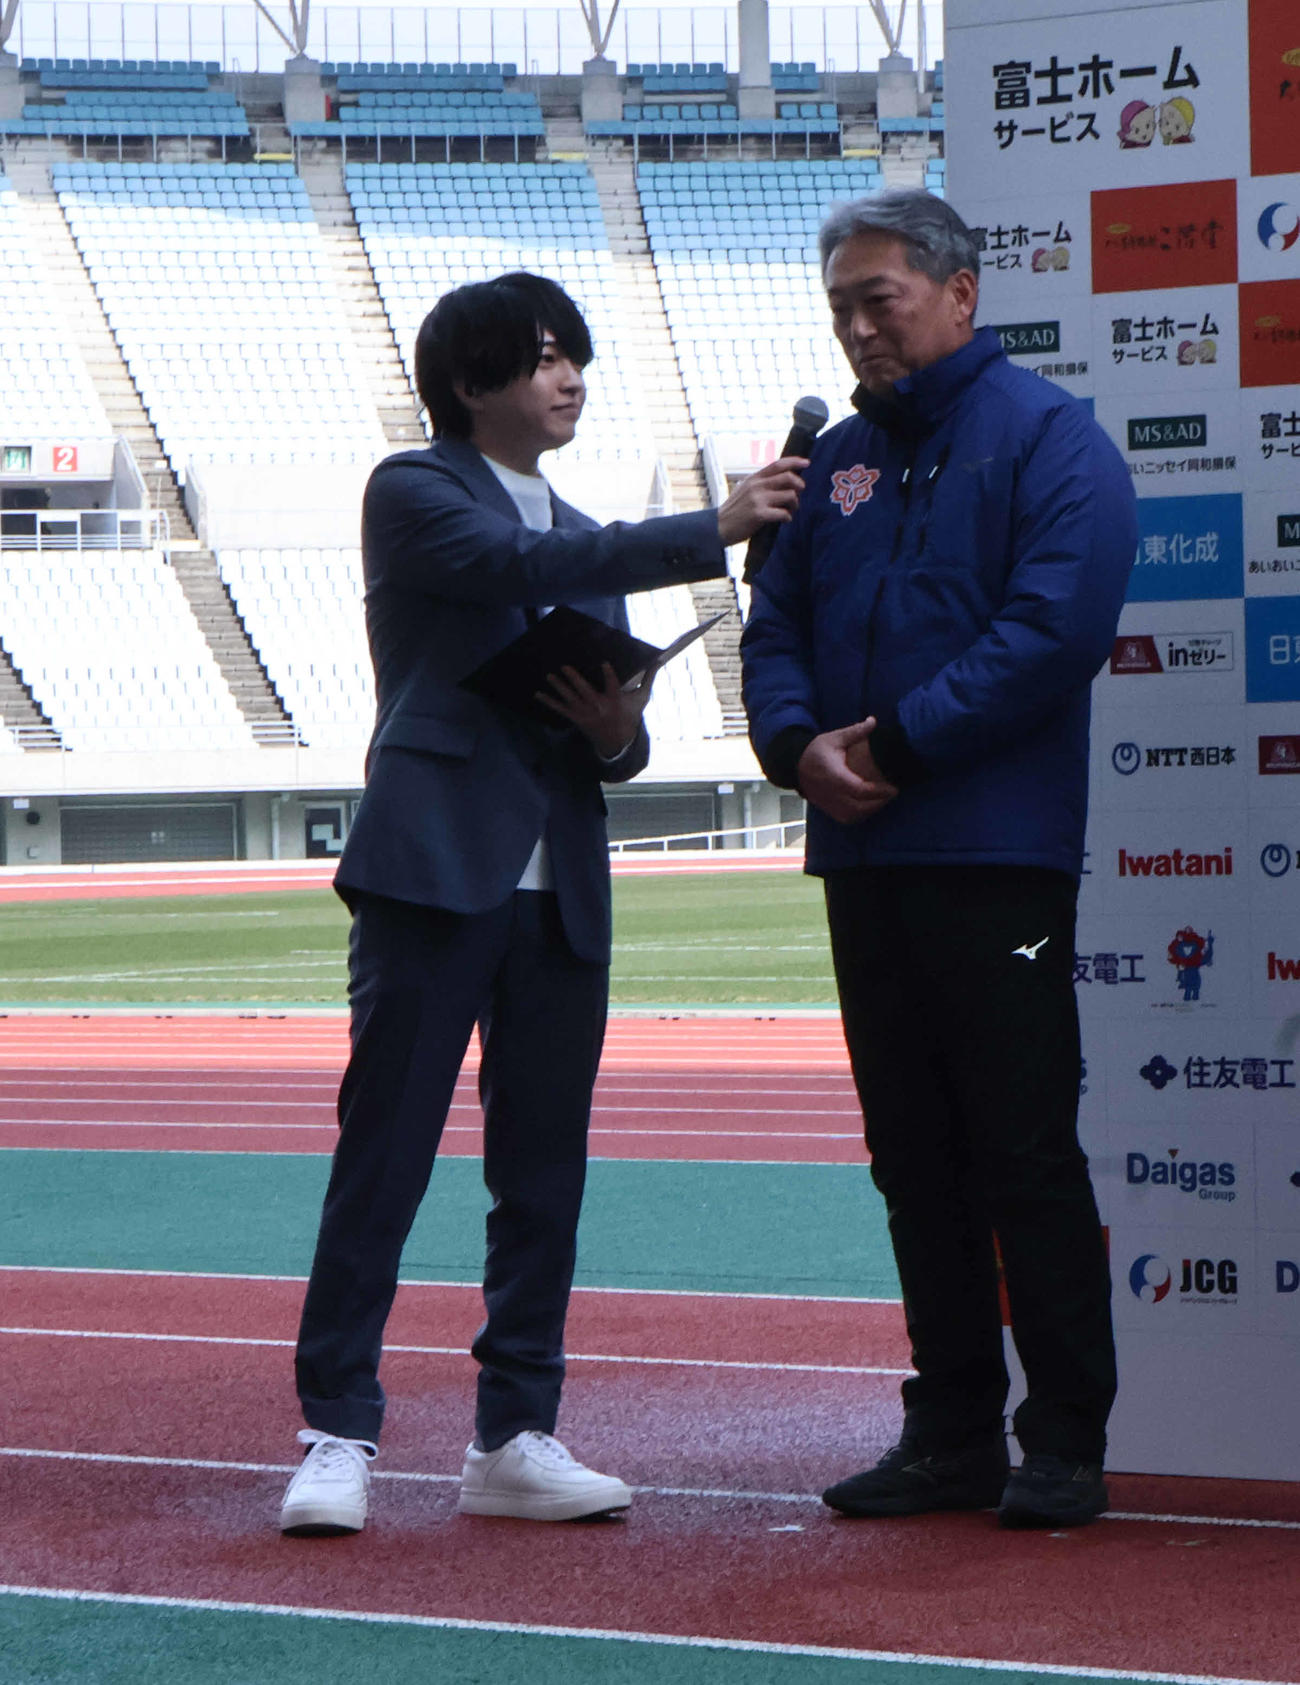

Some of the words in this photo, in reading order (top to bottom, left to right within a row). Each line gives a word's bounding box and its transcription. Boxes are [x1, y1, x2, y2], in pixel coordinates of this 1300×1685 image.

[993, 46, 1200, 109] 富士ホーム
[994, 111, 1100, 149] サービス
[981, 254, 1022, 270] ービス
[1111, 313, 1219, 344] 富士ホーム
[1112, 346, 1168, 364] サービス
[1134, 422, 1201, 442] MS&AD
[56, 447, 74, 471] 2
[1134, 532, 1219, 565] 東化成
[1168, 641, 1227, 666] inゼリー
[1118, 847, 1233, 877] Iwatani
[1184, 1056, 1296, 1090] 住友電工
[1127, 1148, 1236, 1193] Daigas
[1198, 1189, 1236, 1202] Group
[1180, 1259, 1238, 1294] JCG
